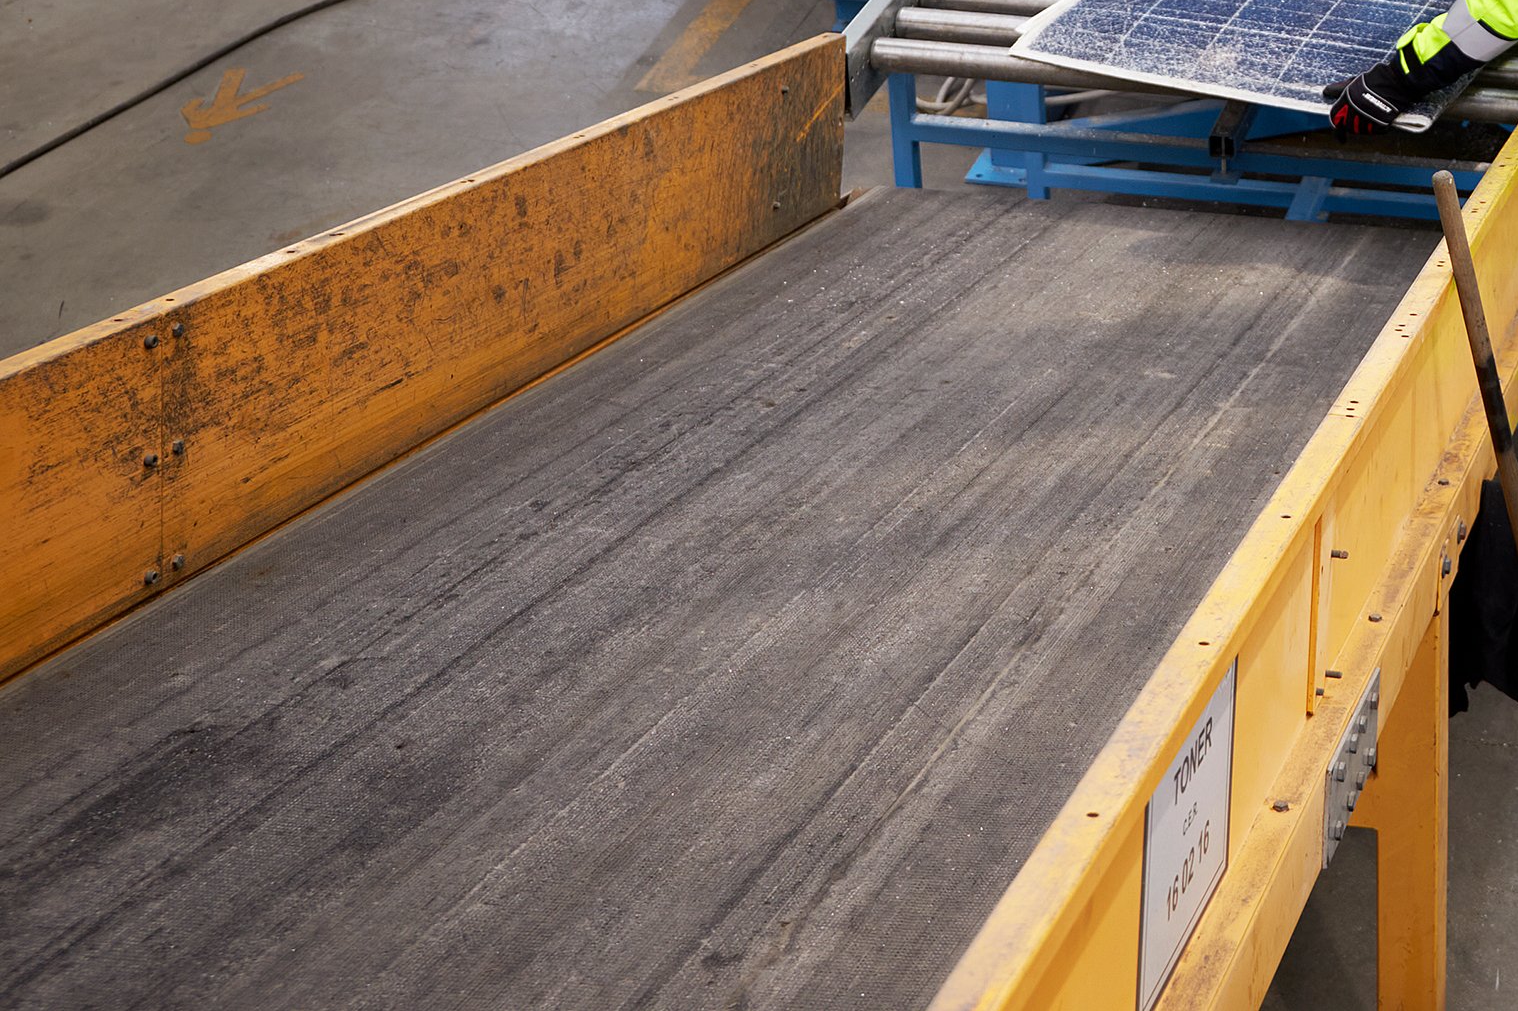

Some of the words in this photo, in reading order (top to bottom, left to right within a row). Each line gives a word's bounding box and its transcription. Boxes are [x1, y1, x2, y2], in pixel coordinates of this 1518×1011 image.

[1174, 716, 1213, 806] TONER
[1167, 874, 1179, 922] 16
[1181, 846, 1195, 895] 02
[1198, 819, 1210, 864] 16
